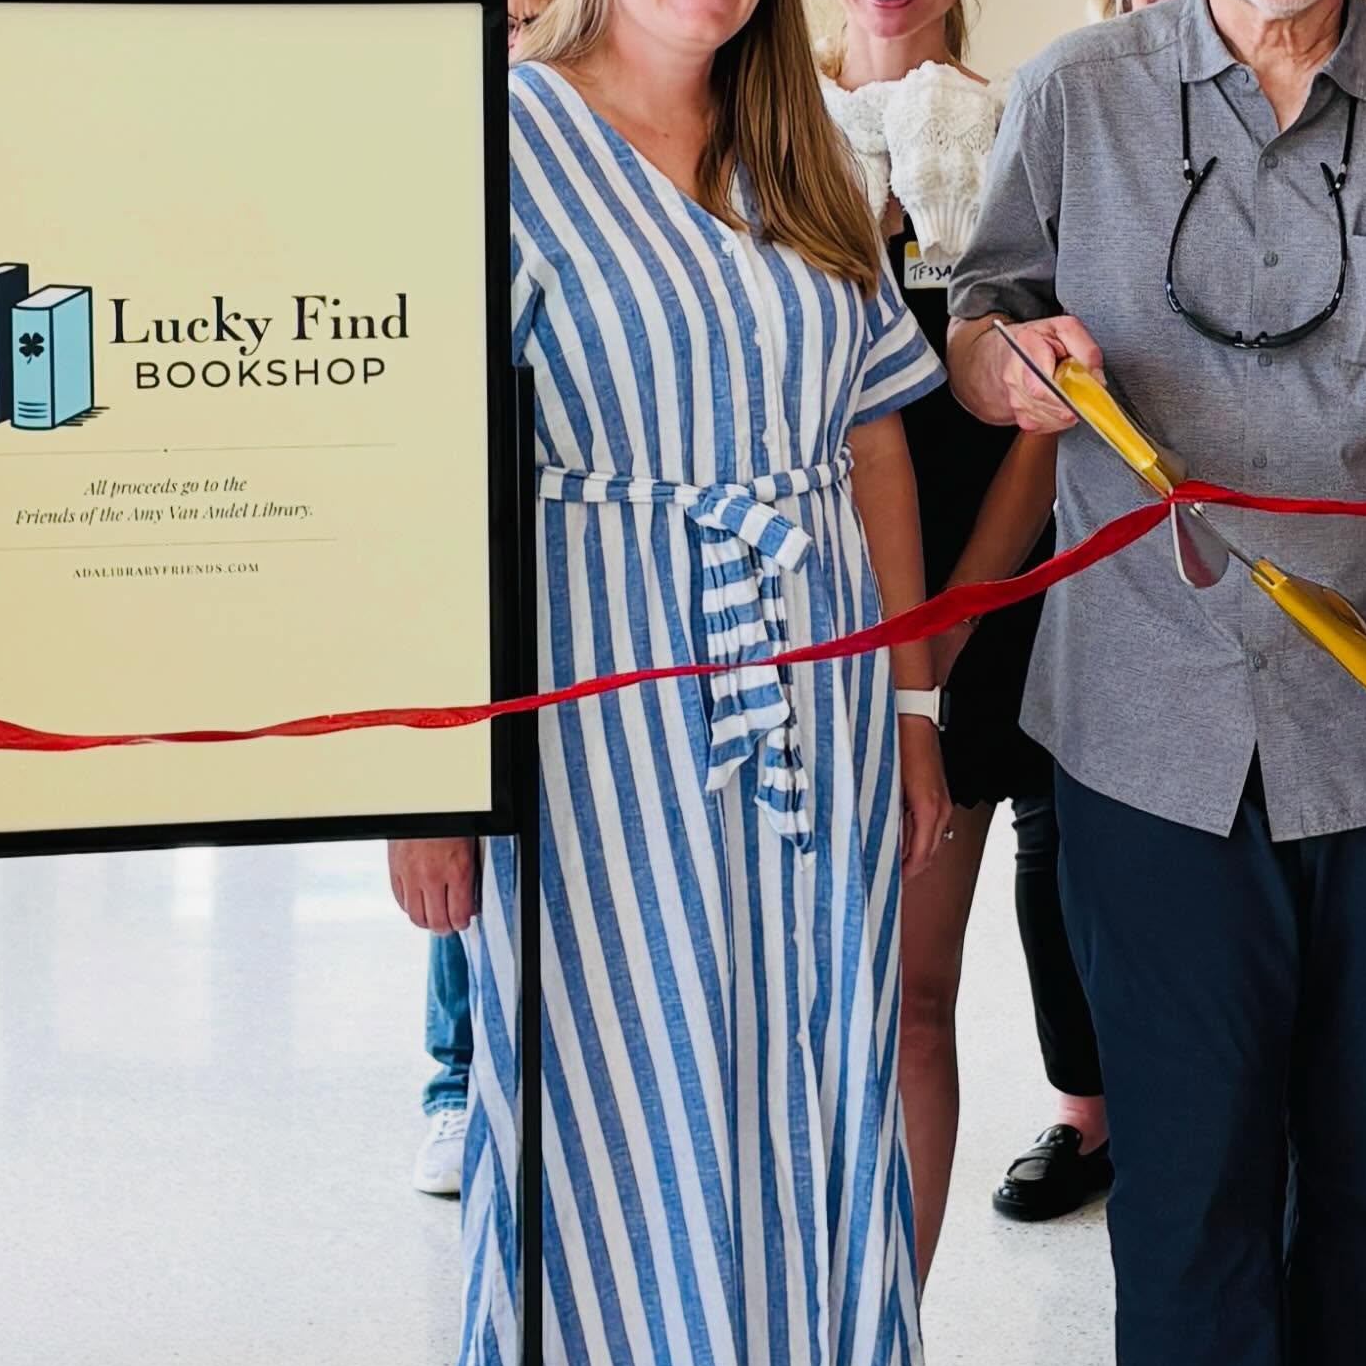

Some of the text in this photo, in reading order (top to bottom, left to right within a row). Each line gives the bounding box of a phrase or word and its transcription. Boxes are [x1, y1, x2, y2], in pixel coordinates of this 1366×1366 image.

[108, 293, 410, 356] Lucky Find
[135, 357, 385, 389] BOOKSHOP
[84, 476, 248, 498] All proceeds go to the
[15, 501, 314, 526] Friends of the Amy Van Andel Library.
[73, 563, 260, 578] ADALIBRARYFRIENDS.COM
